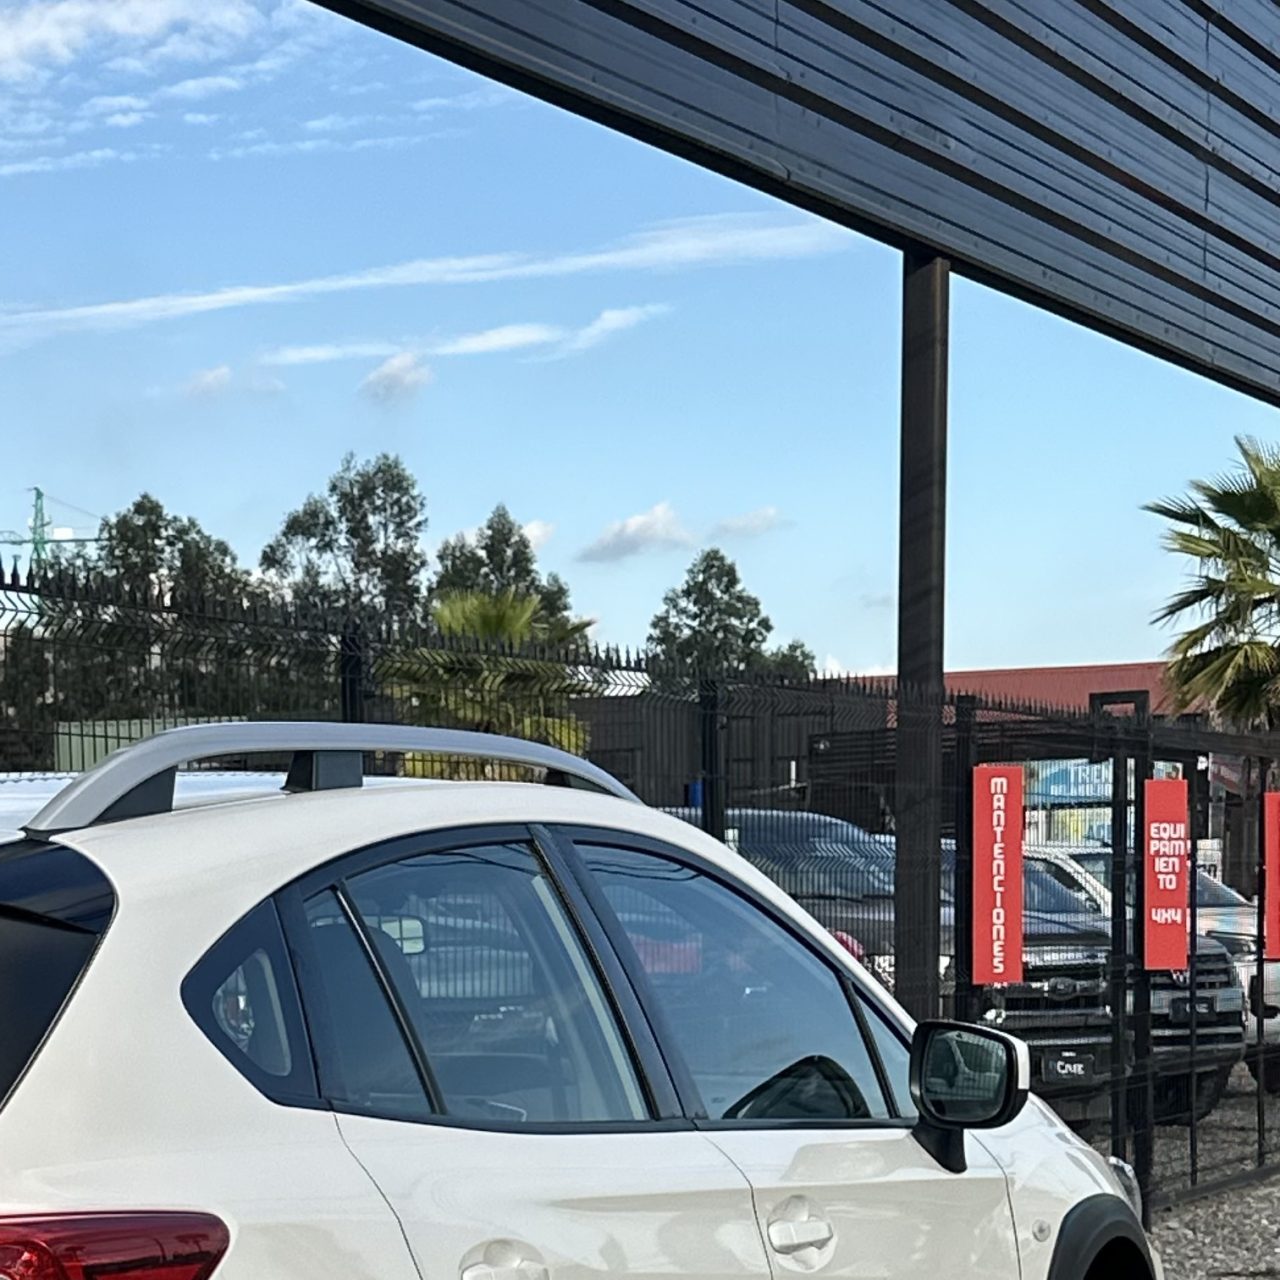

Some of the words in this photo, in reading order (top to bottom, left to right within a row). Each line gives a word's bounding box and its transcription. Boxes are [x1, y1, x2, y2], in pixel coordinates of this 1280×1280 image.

[1149, 822, 1186, 840] EQUI
[1149, 840, 1186, 856] PAM
[1154, 857, 1181, 873] IEN
[990, 776, 1008, 974] MANTENCIONES
[1157, 874, 1177, 890] TO
[1151, 908, 1182, 924] 4X4
